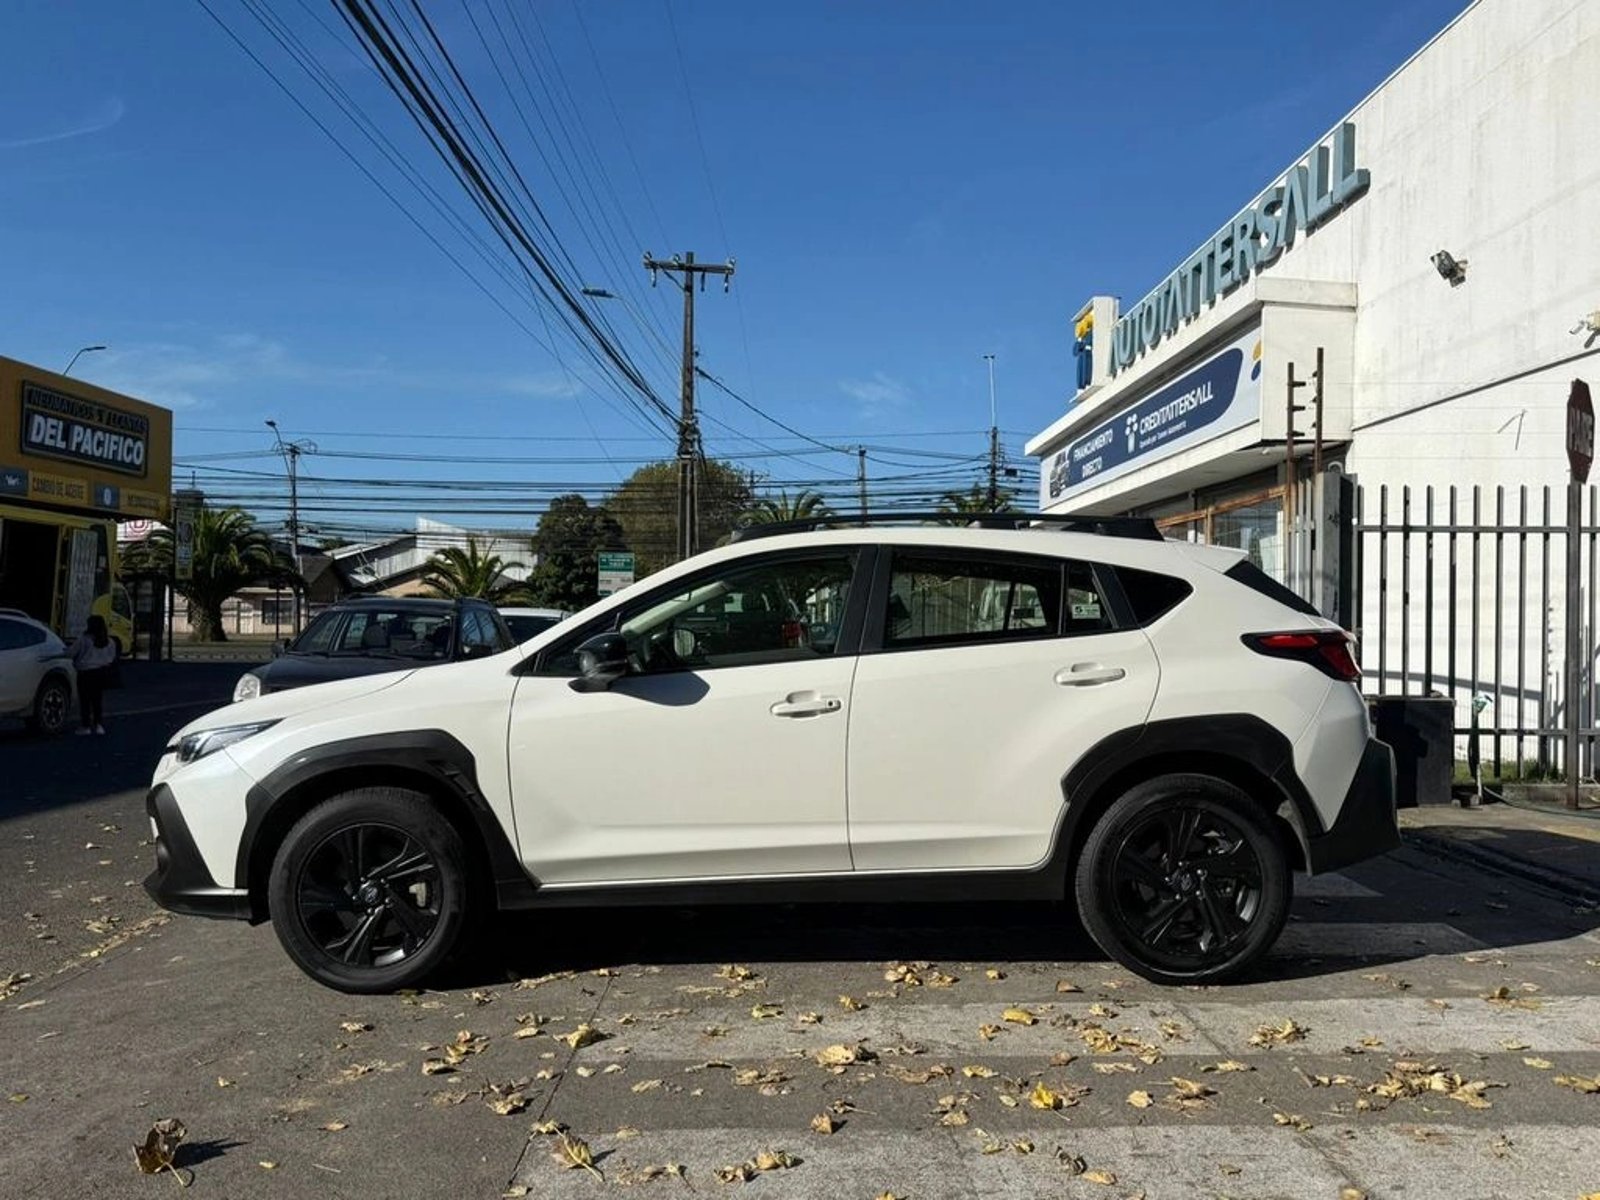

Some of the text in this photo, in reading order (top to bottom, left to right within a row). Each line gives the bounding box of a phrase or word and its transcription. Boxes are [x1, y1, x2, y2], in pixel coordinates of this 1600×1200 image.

[1107, 122, 1370, 377] AUTOTATTERSALL
[30, 414, 144, 465] DEL PACIFICO
